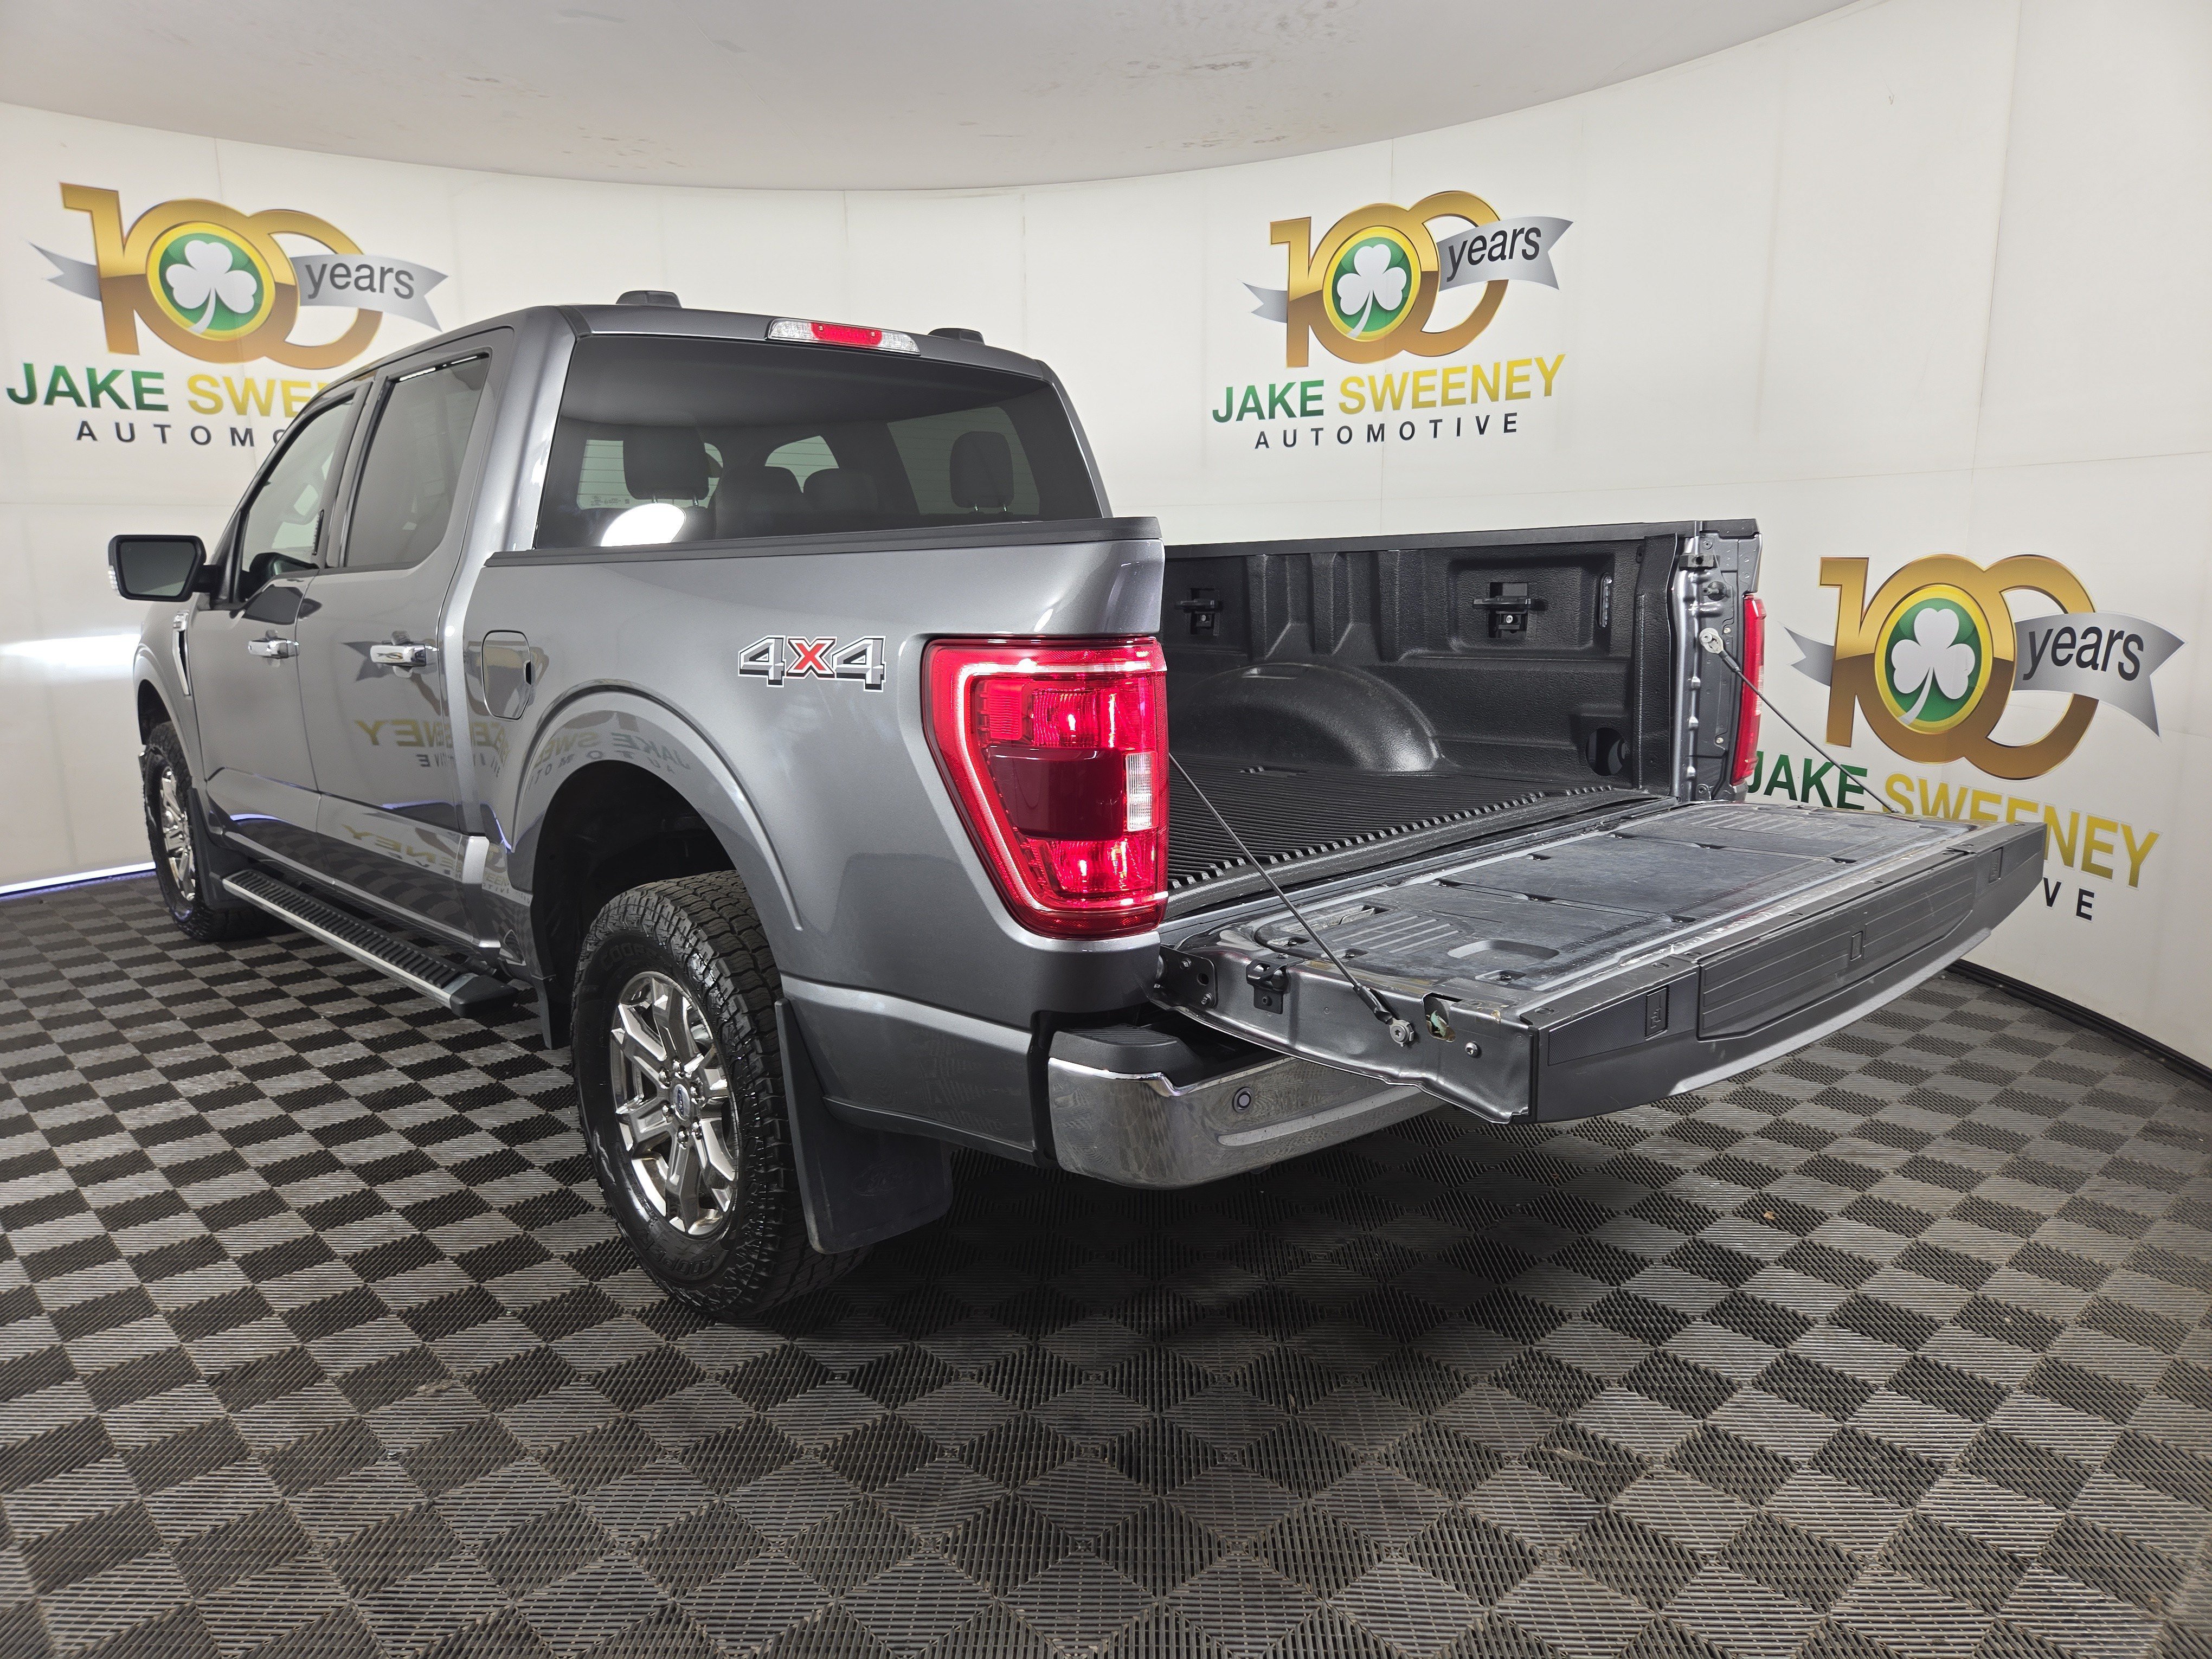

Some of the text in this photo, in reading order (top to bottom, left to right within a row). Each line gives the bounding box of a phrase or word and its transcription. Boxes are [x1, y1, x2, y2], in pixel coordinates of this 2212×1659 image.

[60, 182, 415, 370] 100 years
[1270, 190, 1542, 369] 100 years
[7, 362, 330, 417] JAKE SWE
[1212, 353, 1566, 423] JAKE SWEENEY
[1255, 412, 1517, 449] AUTOMOTIVE
[1819, 554, 2145, 780] 100 years
[1747, 751, 1868, 811] JAKE
